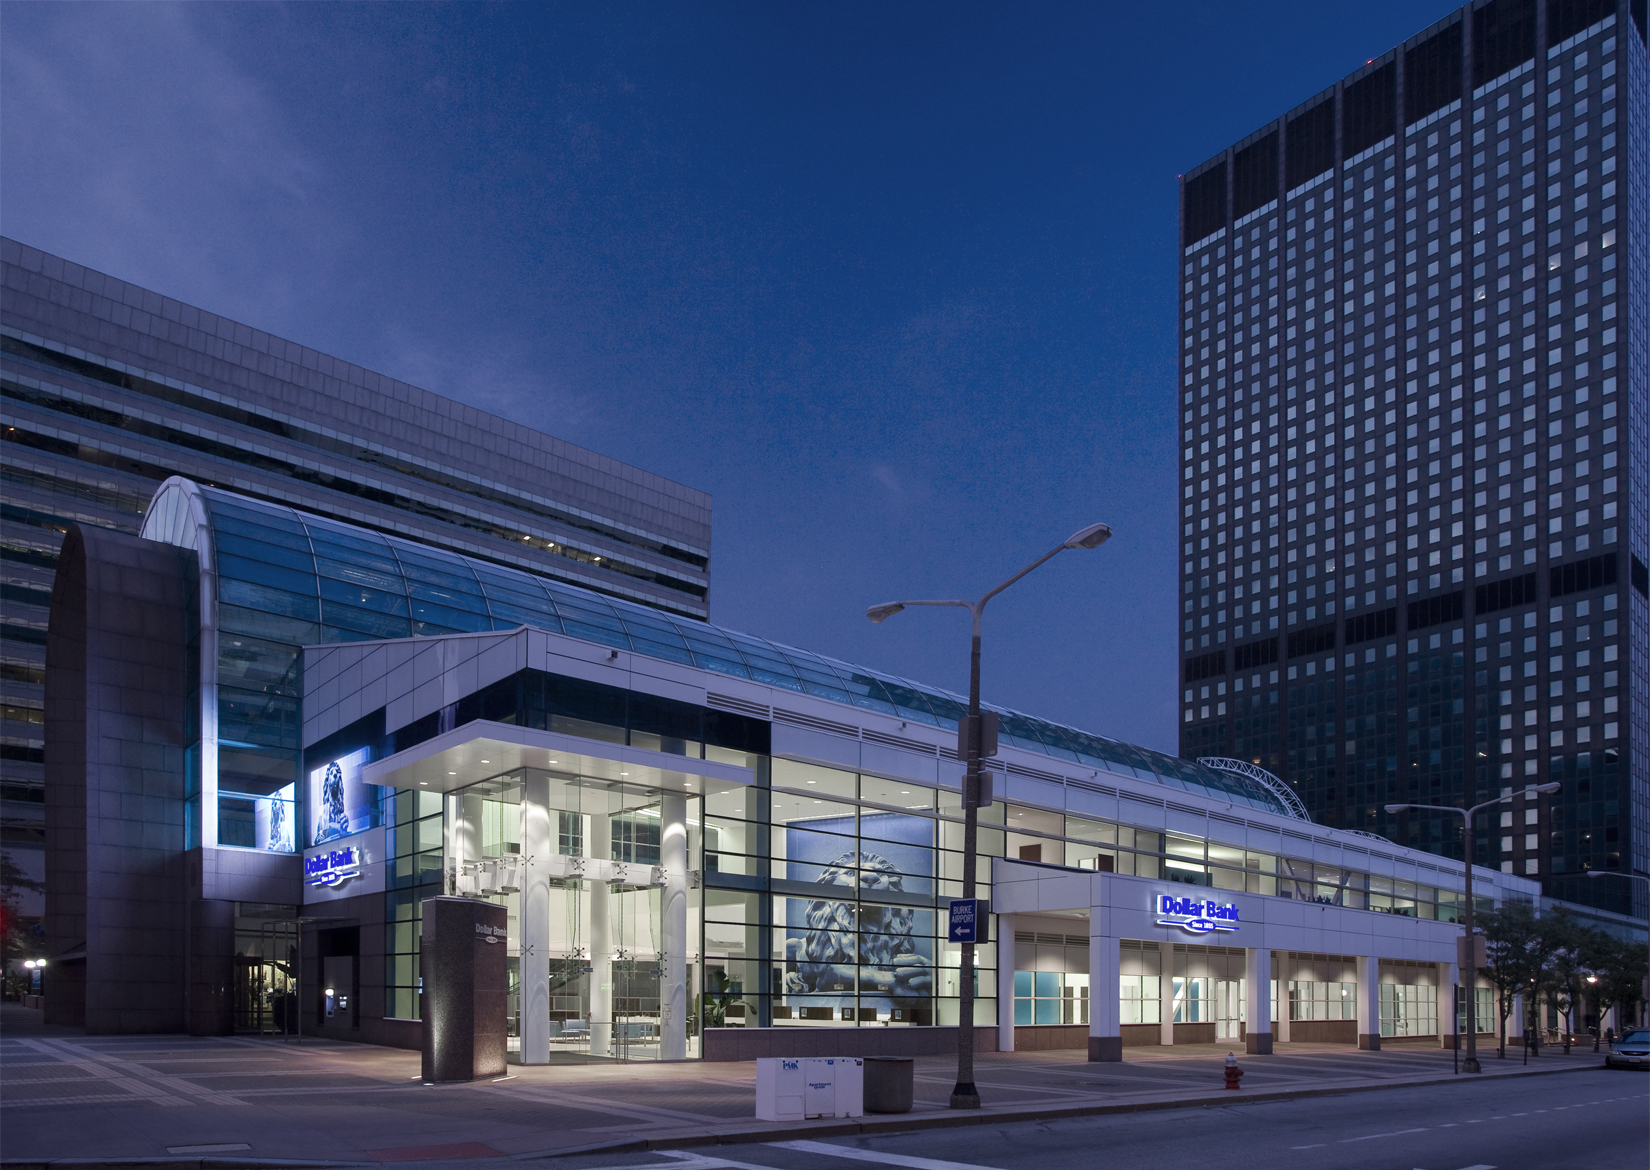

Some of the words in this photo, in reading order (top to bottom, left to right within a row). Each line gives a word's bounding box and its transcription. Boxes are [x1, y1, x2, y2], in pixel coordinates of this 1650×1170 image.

[304, 854, 329, 875] Dollar
[330, 846, 354, 868] Bank
[952, 905, 973, 915] BURKE
[1162, 895, 1204, 917] Dollar
[1206, 900, 1240, 921] Bank
[951, 913, 974, 924] AIRPORT
[475, 922, 493, 935] Dollar
